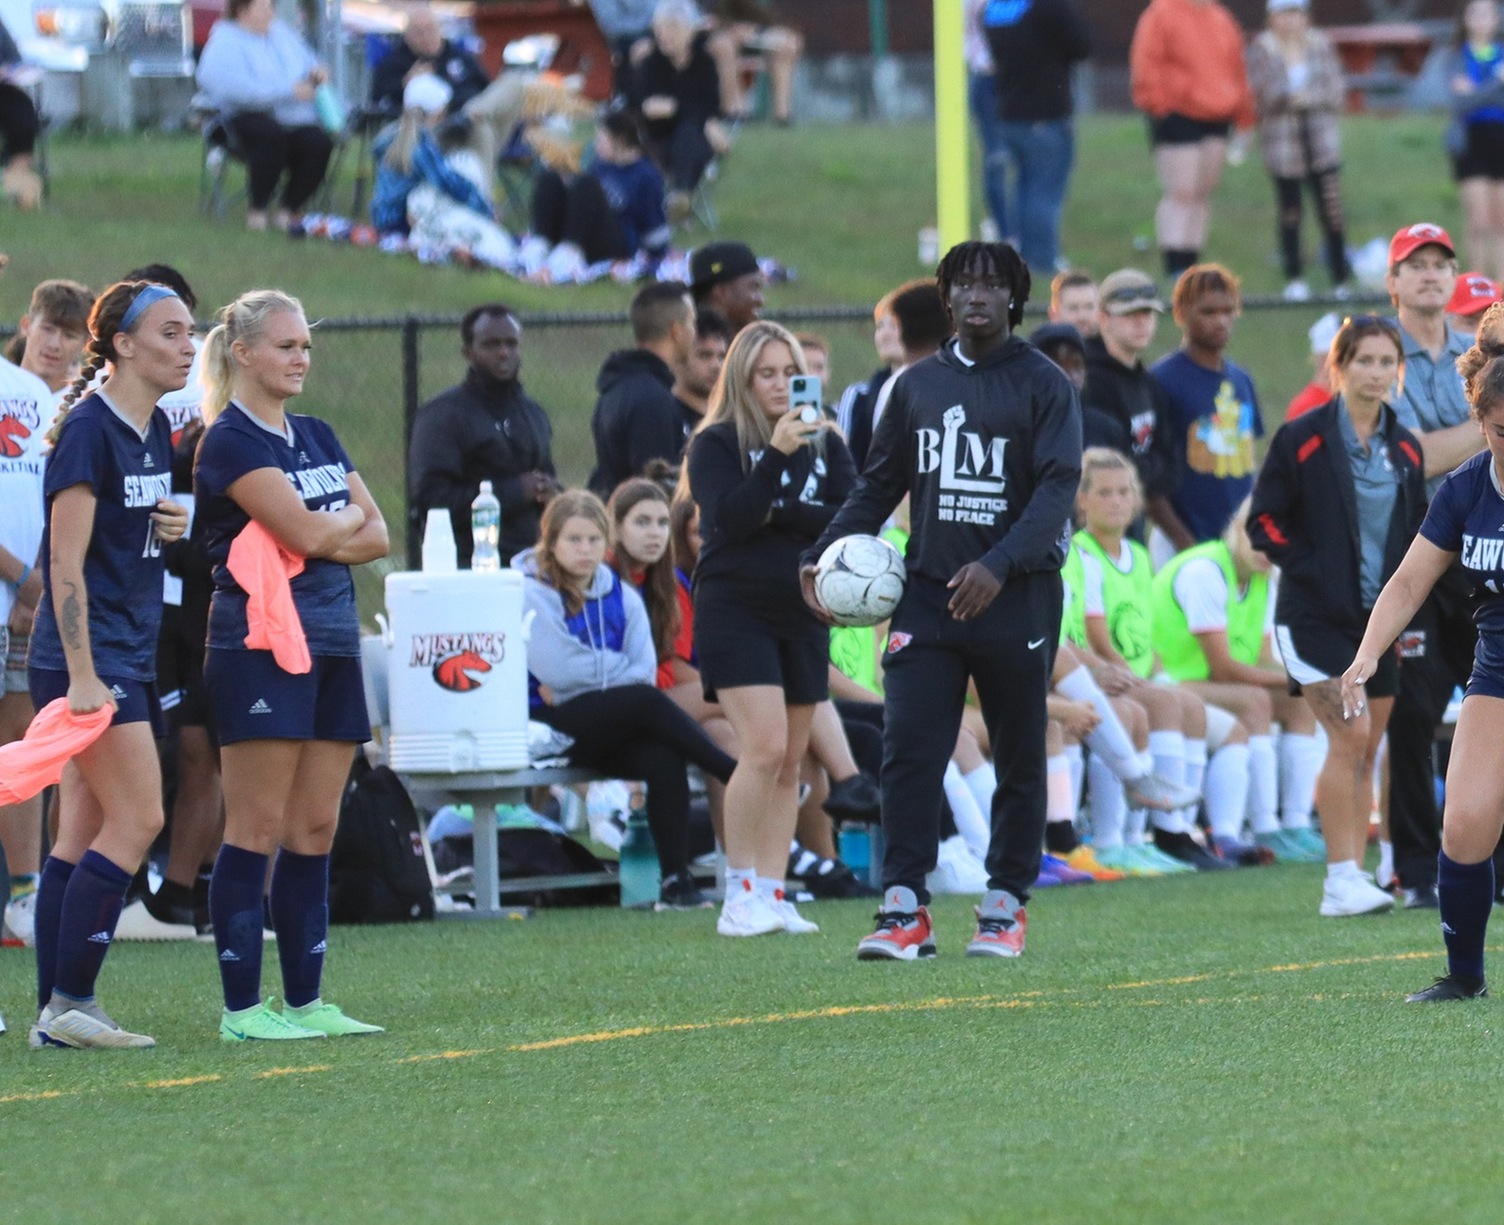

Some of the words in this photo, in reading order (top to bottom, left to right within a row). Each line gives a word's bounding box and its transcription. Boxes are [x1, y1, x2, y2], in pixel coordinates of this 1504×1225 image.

[916, 404, 1010, 494] BLM
[938, 508, 954, 521] NO
[955, 509, 995, 526] PEACE
[939, 494, 955, 507] NO
[956, 495, 1008, 513] JUSTICE
[409, 632, 505, 667] MUSTANGS
